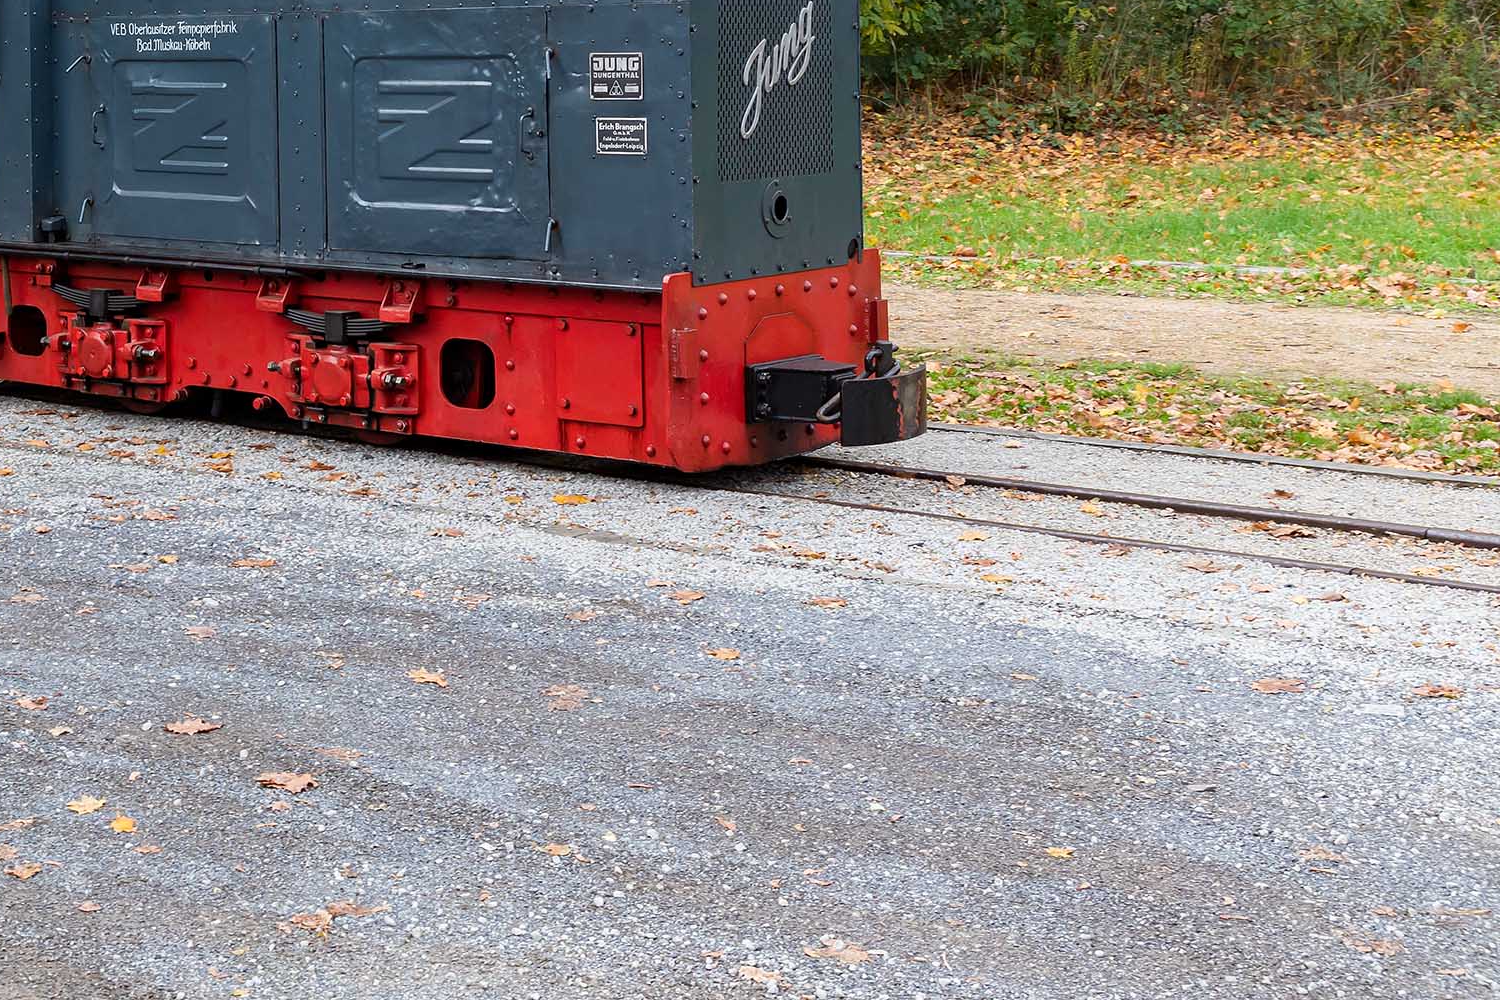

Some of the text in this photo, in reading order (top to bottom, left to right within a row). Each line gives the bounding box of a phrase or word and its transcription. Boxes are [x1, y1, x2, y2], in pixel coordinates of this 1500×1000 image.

[110, 20, 238, 38] VEB Oberlausitzer Feinpapierfabrik
[136, 38, 152, 52] Bad
[592, 57, 639, 71] JUNG
[741, 0, 815, 139] Jung
[599, 122, 644, 132] Erich Brangsch
